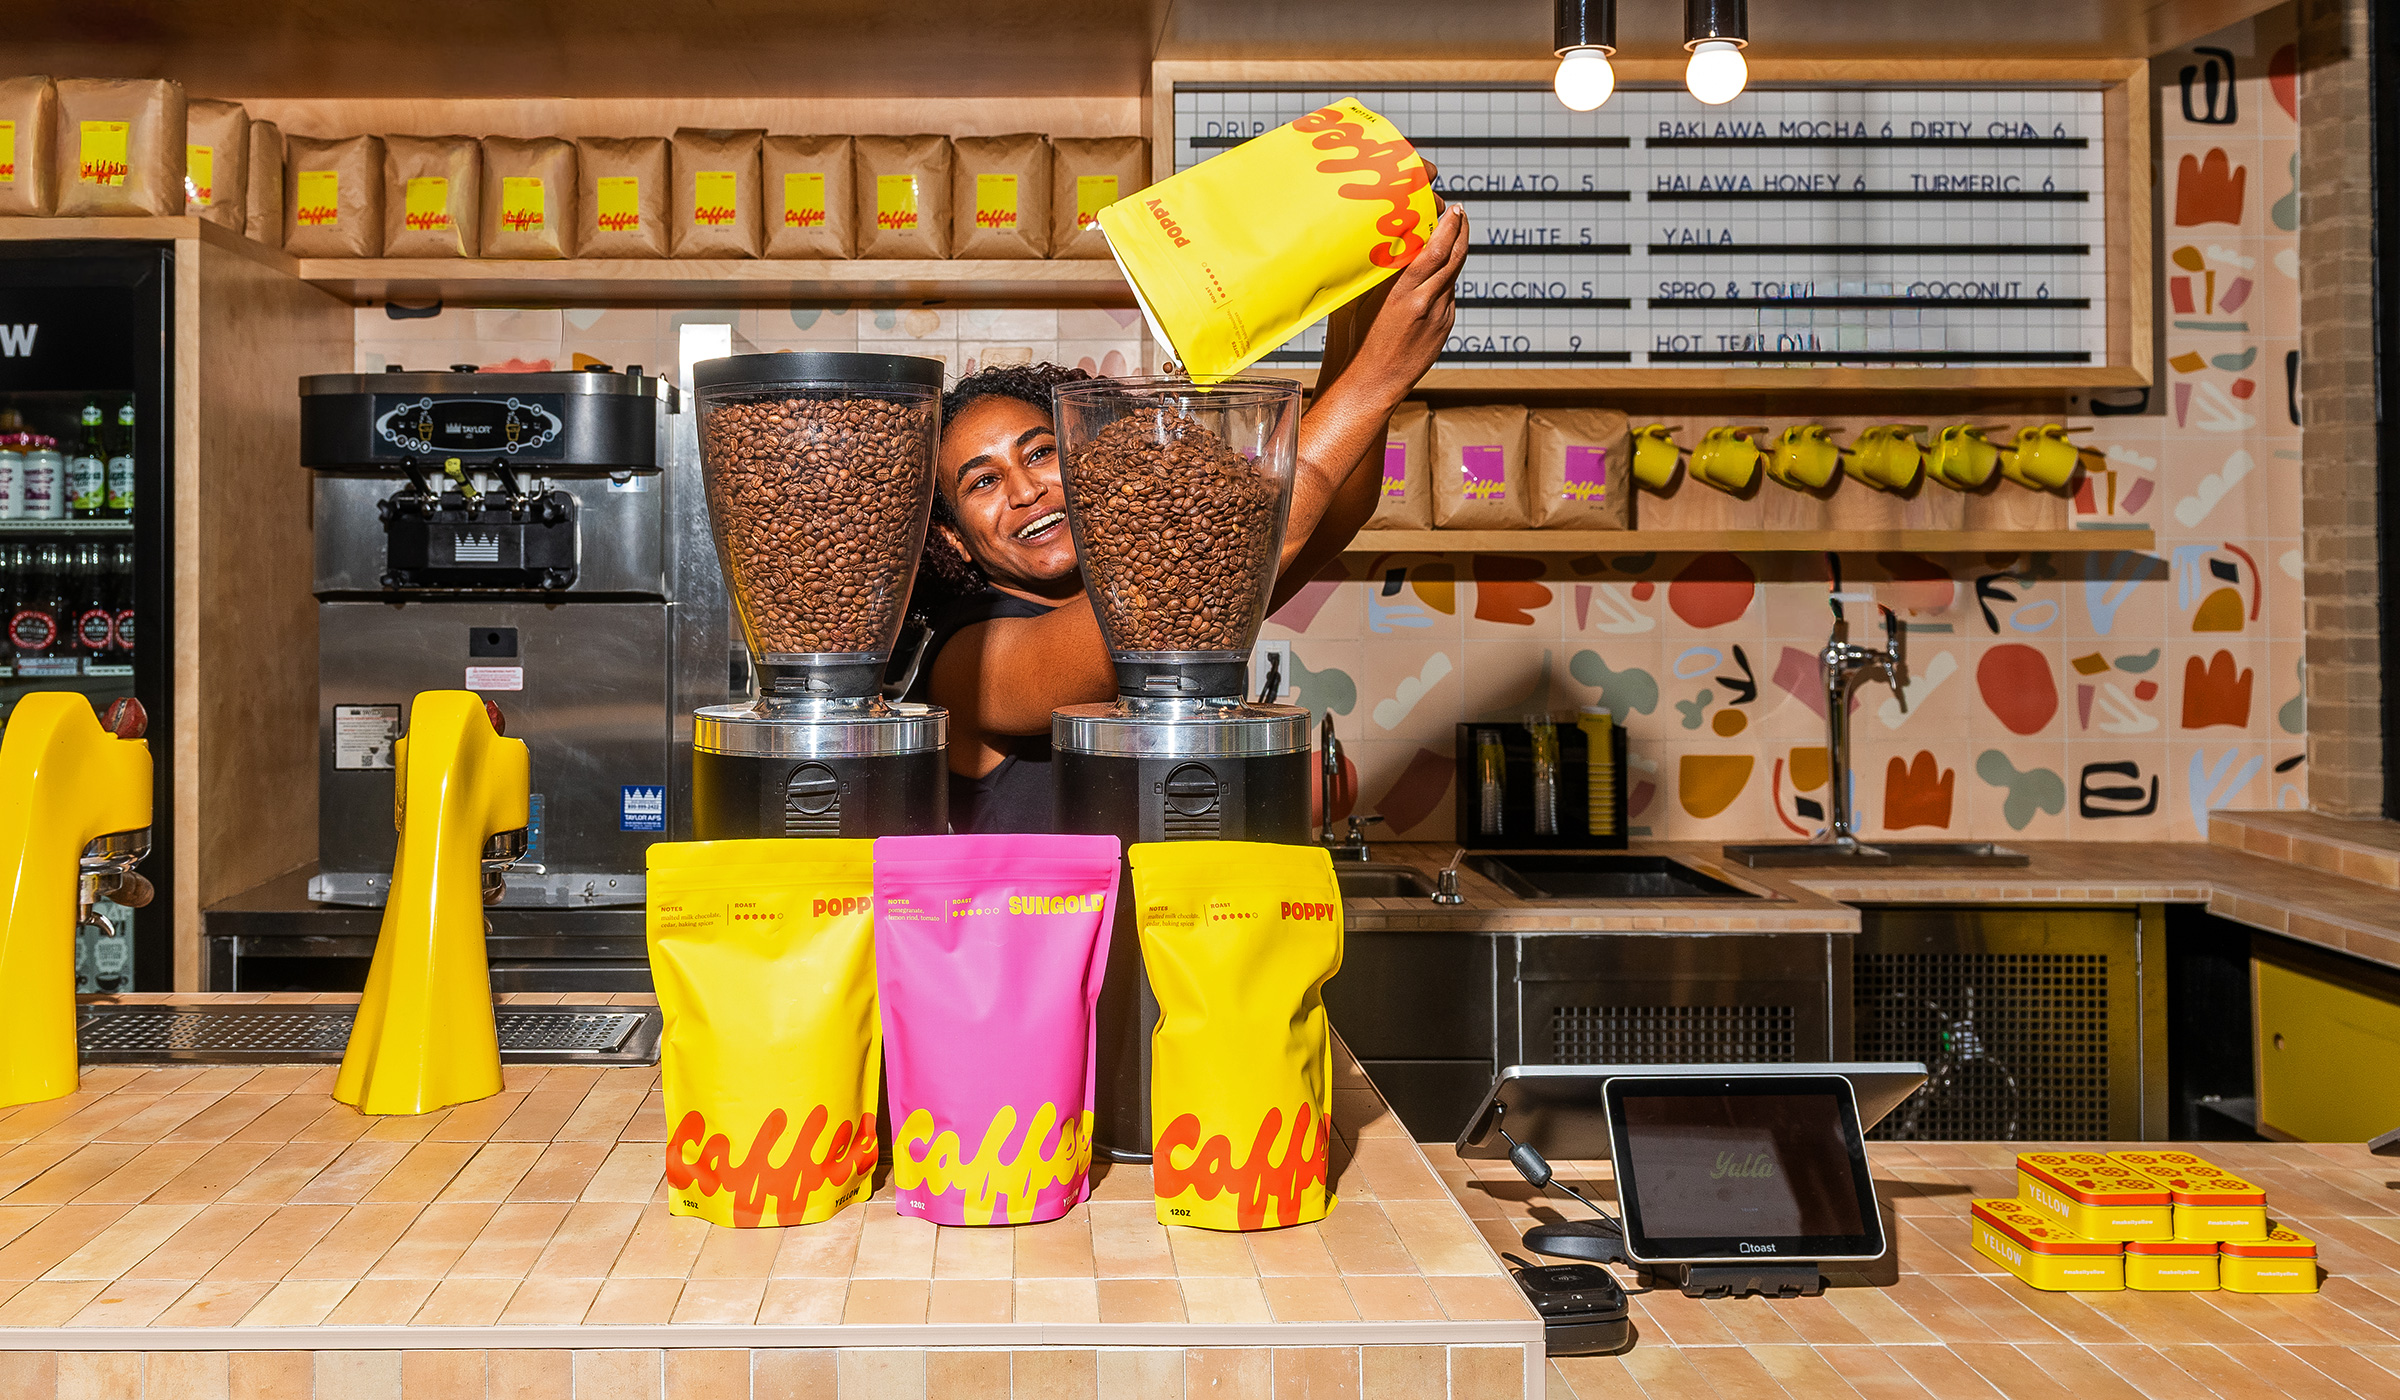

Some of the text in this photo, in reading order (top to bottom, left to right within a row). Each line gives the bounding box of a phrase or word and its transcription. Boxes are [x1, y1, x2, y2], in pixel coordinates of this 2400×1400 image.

[1207, 122, 1265, 138] DRIP
[1659, 120, 1893, 138] BAKLAWA MOCHA 6
[1910, 121, 1972, 138] DIRTY
[2053, 121, 2066, 138] 6
[1433, 174, 1594, 192] ACCHIATO 5
[1657, 174, 1866, 192] HALAWA HONEY 6
[1910, 174, 2055, 192] TURMERIC 6
[1146, 198, 1191, 248] POPPY
[1486, 227, 1592, 245] WHITE 5
[1662, 227, 1734, 245] YALLA
[1581, 282, 1594, 299] 5
[1659, 282, 1716, 299] SPRO
[1725, 282, 1740, 299] &
[1908, 281, 2048, 299] COCONUT 6
[1569, 336, 1582, 352] 9
[1656, 335, 1702, 352] HOT
[462, 426, 490, 434] TAYLOR
[813, 896, 874, 918] POPP
[1008, 893, 1106, 916] SUNGOLD
[1281, 900, 1334, 922] POPPY
[834, 1186, 860, 1208] YELLOW
[2029, 1184, 2070, 1218] YELLOW
[1750, 1243, 1777, 1253] toast
[1983, 1231, 2022, 1266] YELLOW
